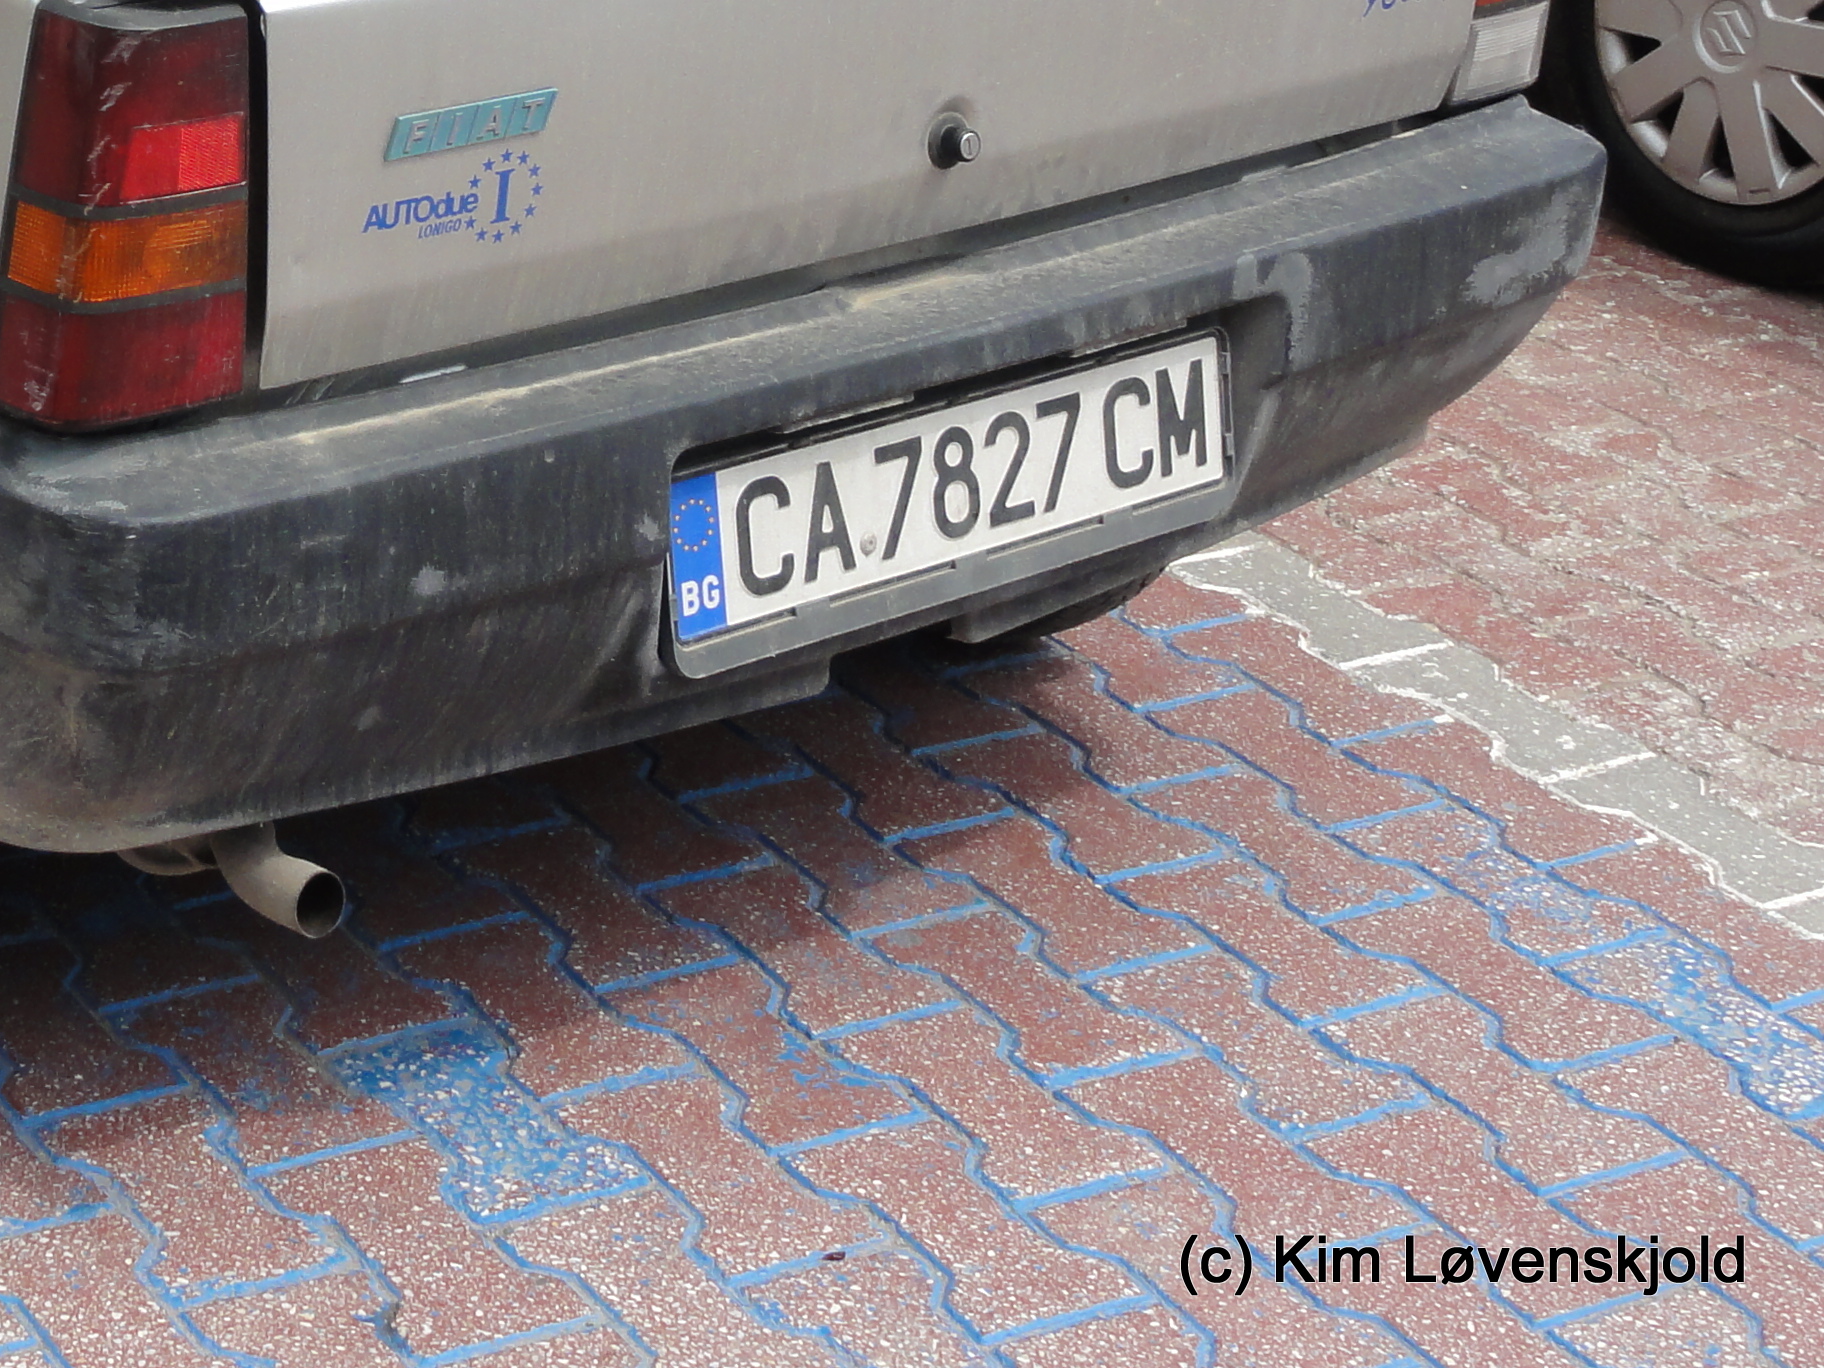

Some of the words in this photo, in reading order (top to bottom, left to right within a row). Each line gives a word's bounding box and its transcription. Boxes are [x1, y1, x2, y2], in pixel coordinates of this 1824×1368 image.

[402, 96, 547, 155] FIAT
[362, 191, 479, 233] AUTOdue
[418, 217, 463, 239] LONIGO
[735, 461, 857, 597] CA
[874, 391, 1081, 561] 7827
[1102, 359, 1208, 489] CM
[681, 575, 720, 616] BG
